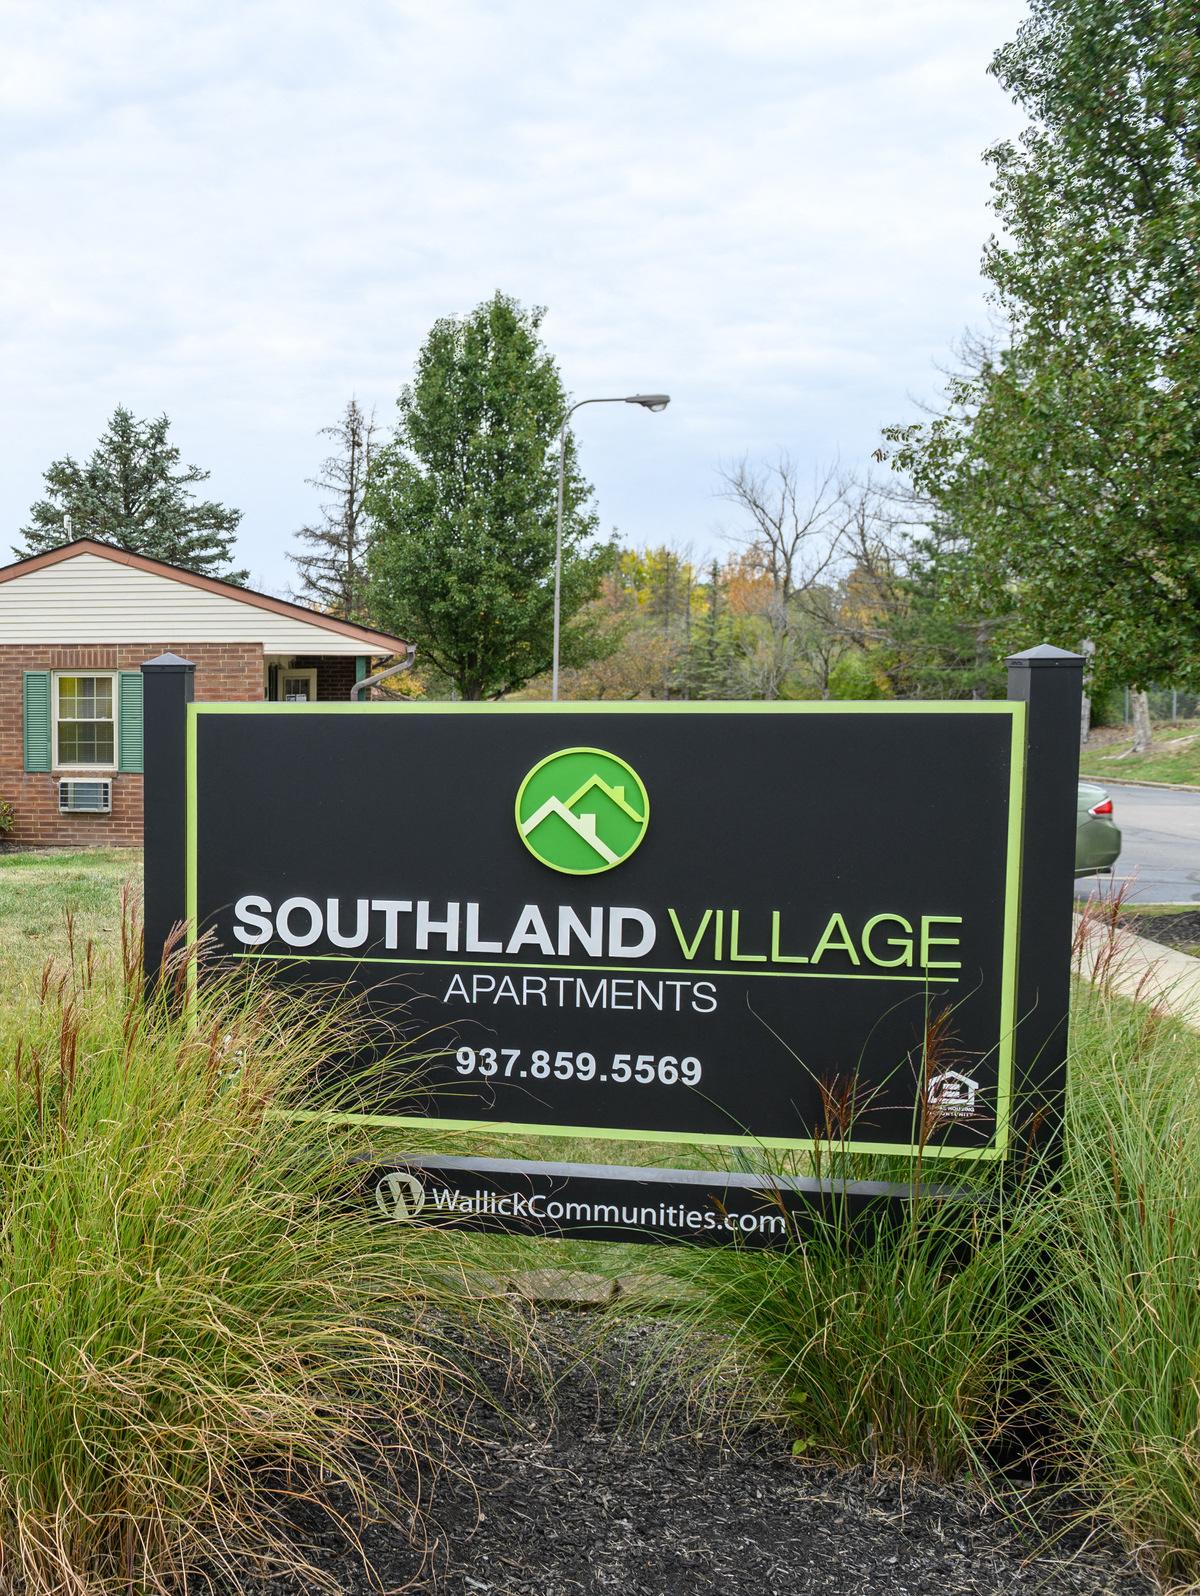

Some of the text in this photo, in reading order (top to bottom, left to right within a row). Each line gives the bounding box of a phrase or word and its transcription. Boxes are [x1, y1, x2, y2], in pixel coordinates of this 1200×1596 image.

[233, 895, 963, 969] SOUTHLAND VILLAGE
[443, 974, 718, 1013] APARTMENTS
[456, 1046, 702, 1086] 937.859.5569
[432, 1188, 787, 1234] WallickCommunities.com
